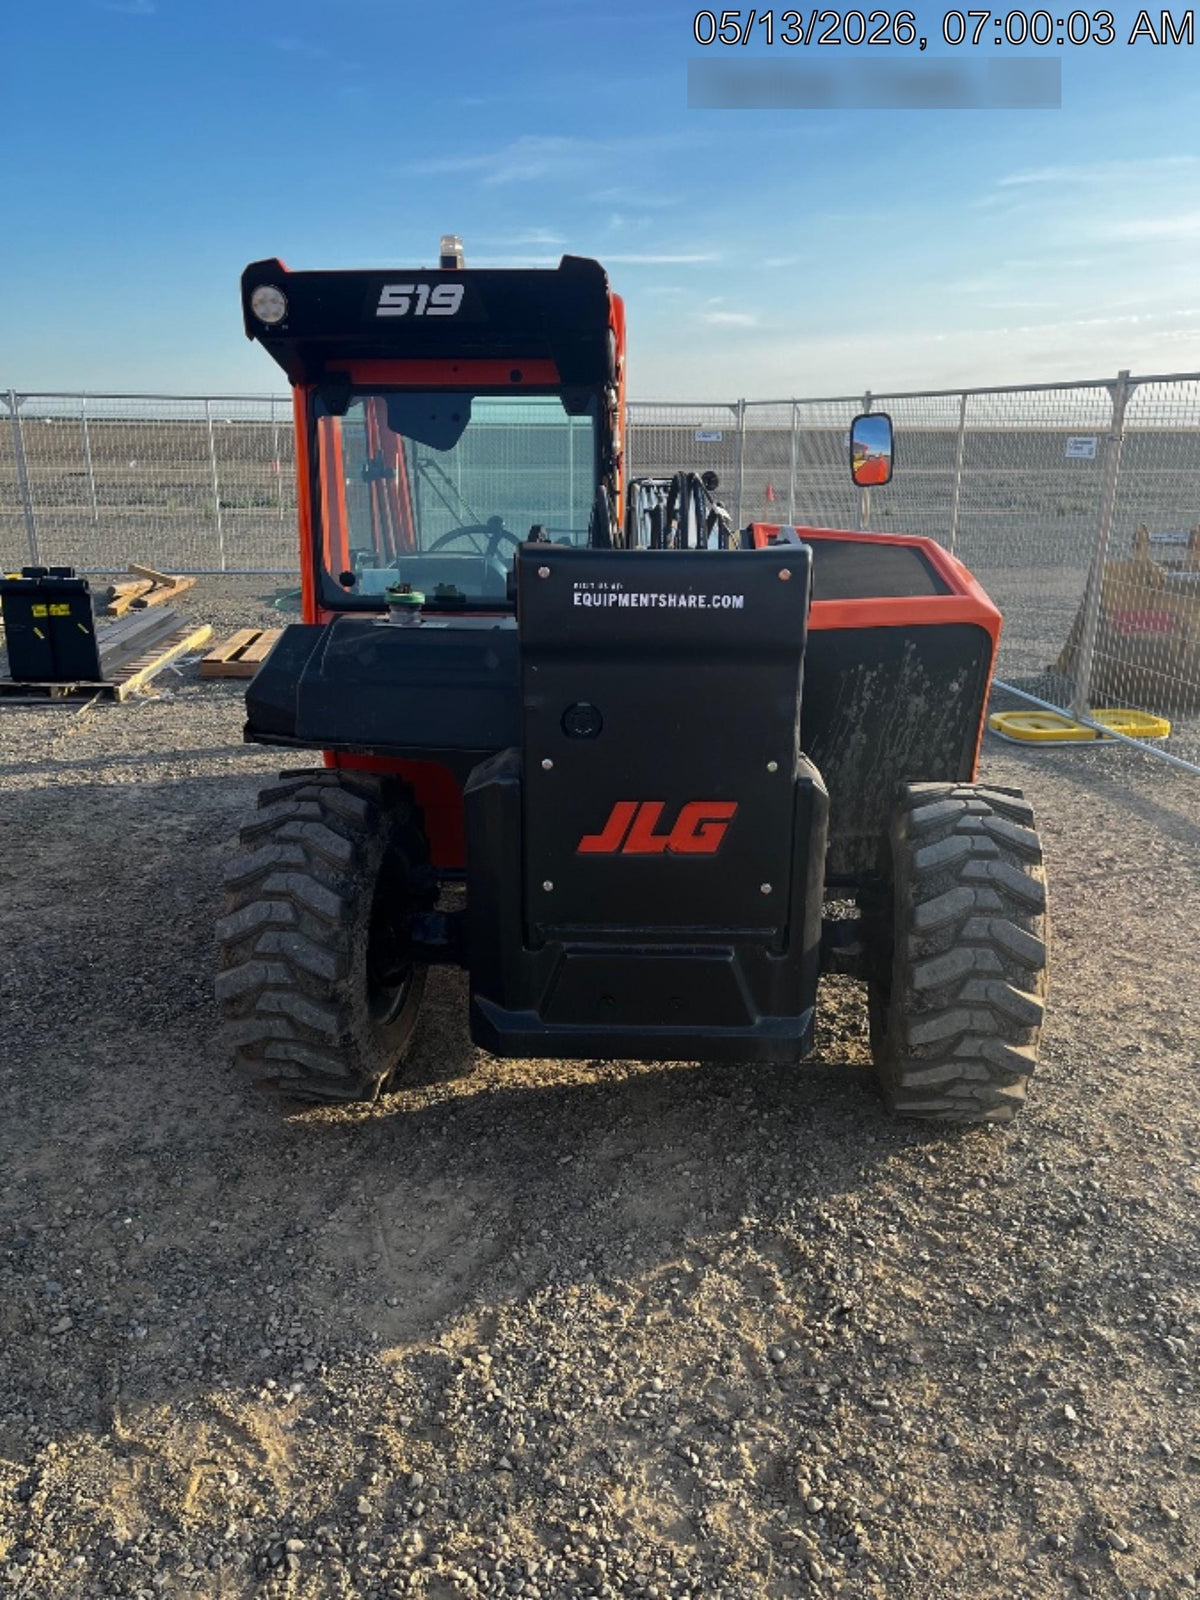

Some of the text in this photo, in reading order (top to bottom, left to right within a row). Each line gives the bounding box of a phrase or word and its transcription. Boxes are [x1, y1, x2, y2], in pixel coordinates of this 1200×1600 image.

[376, 284, 465, 316] 519
[573, 592, 745, 608] EQUIPMENTSHARE.COM
[577, 801, 738, 854] JLG
